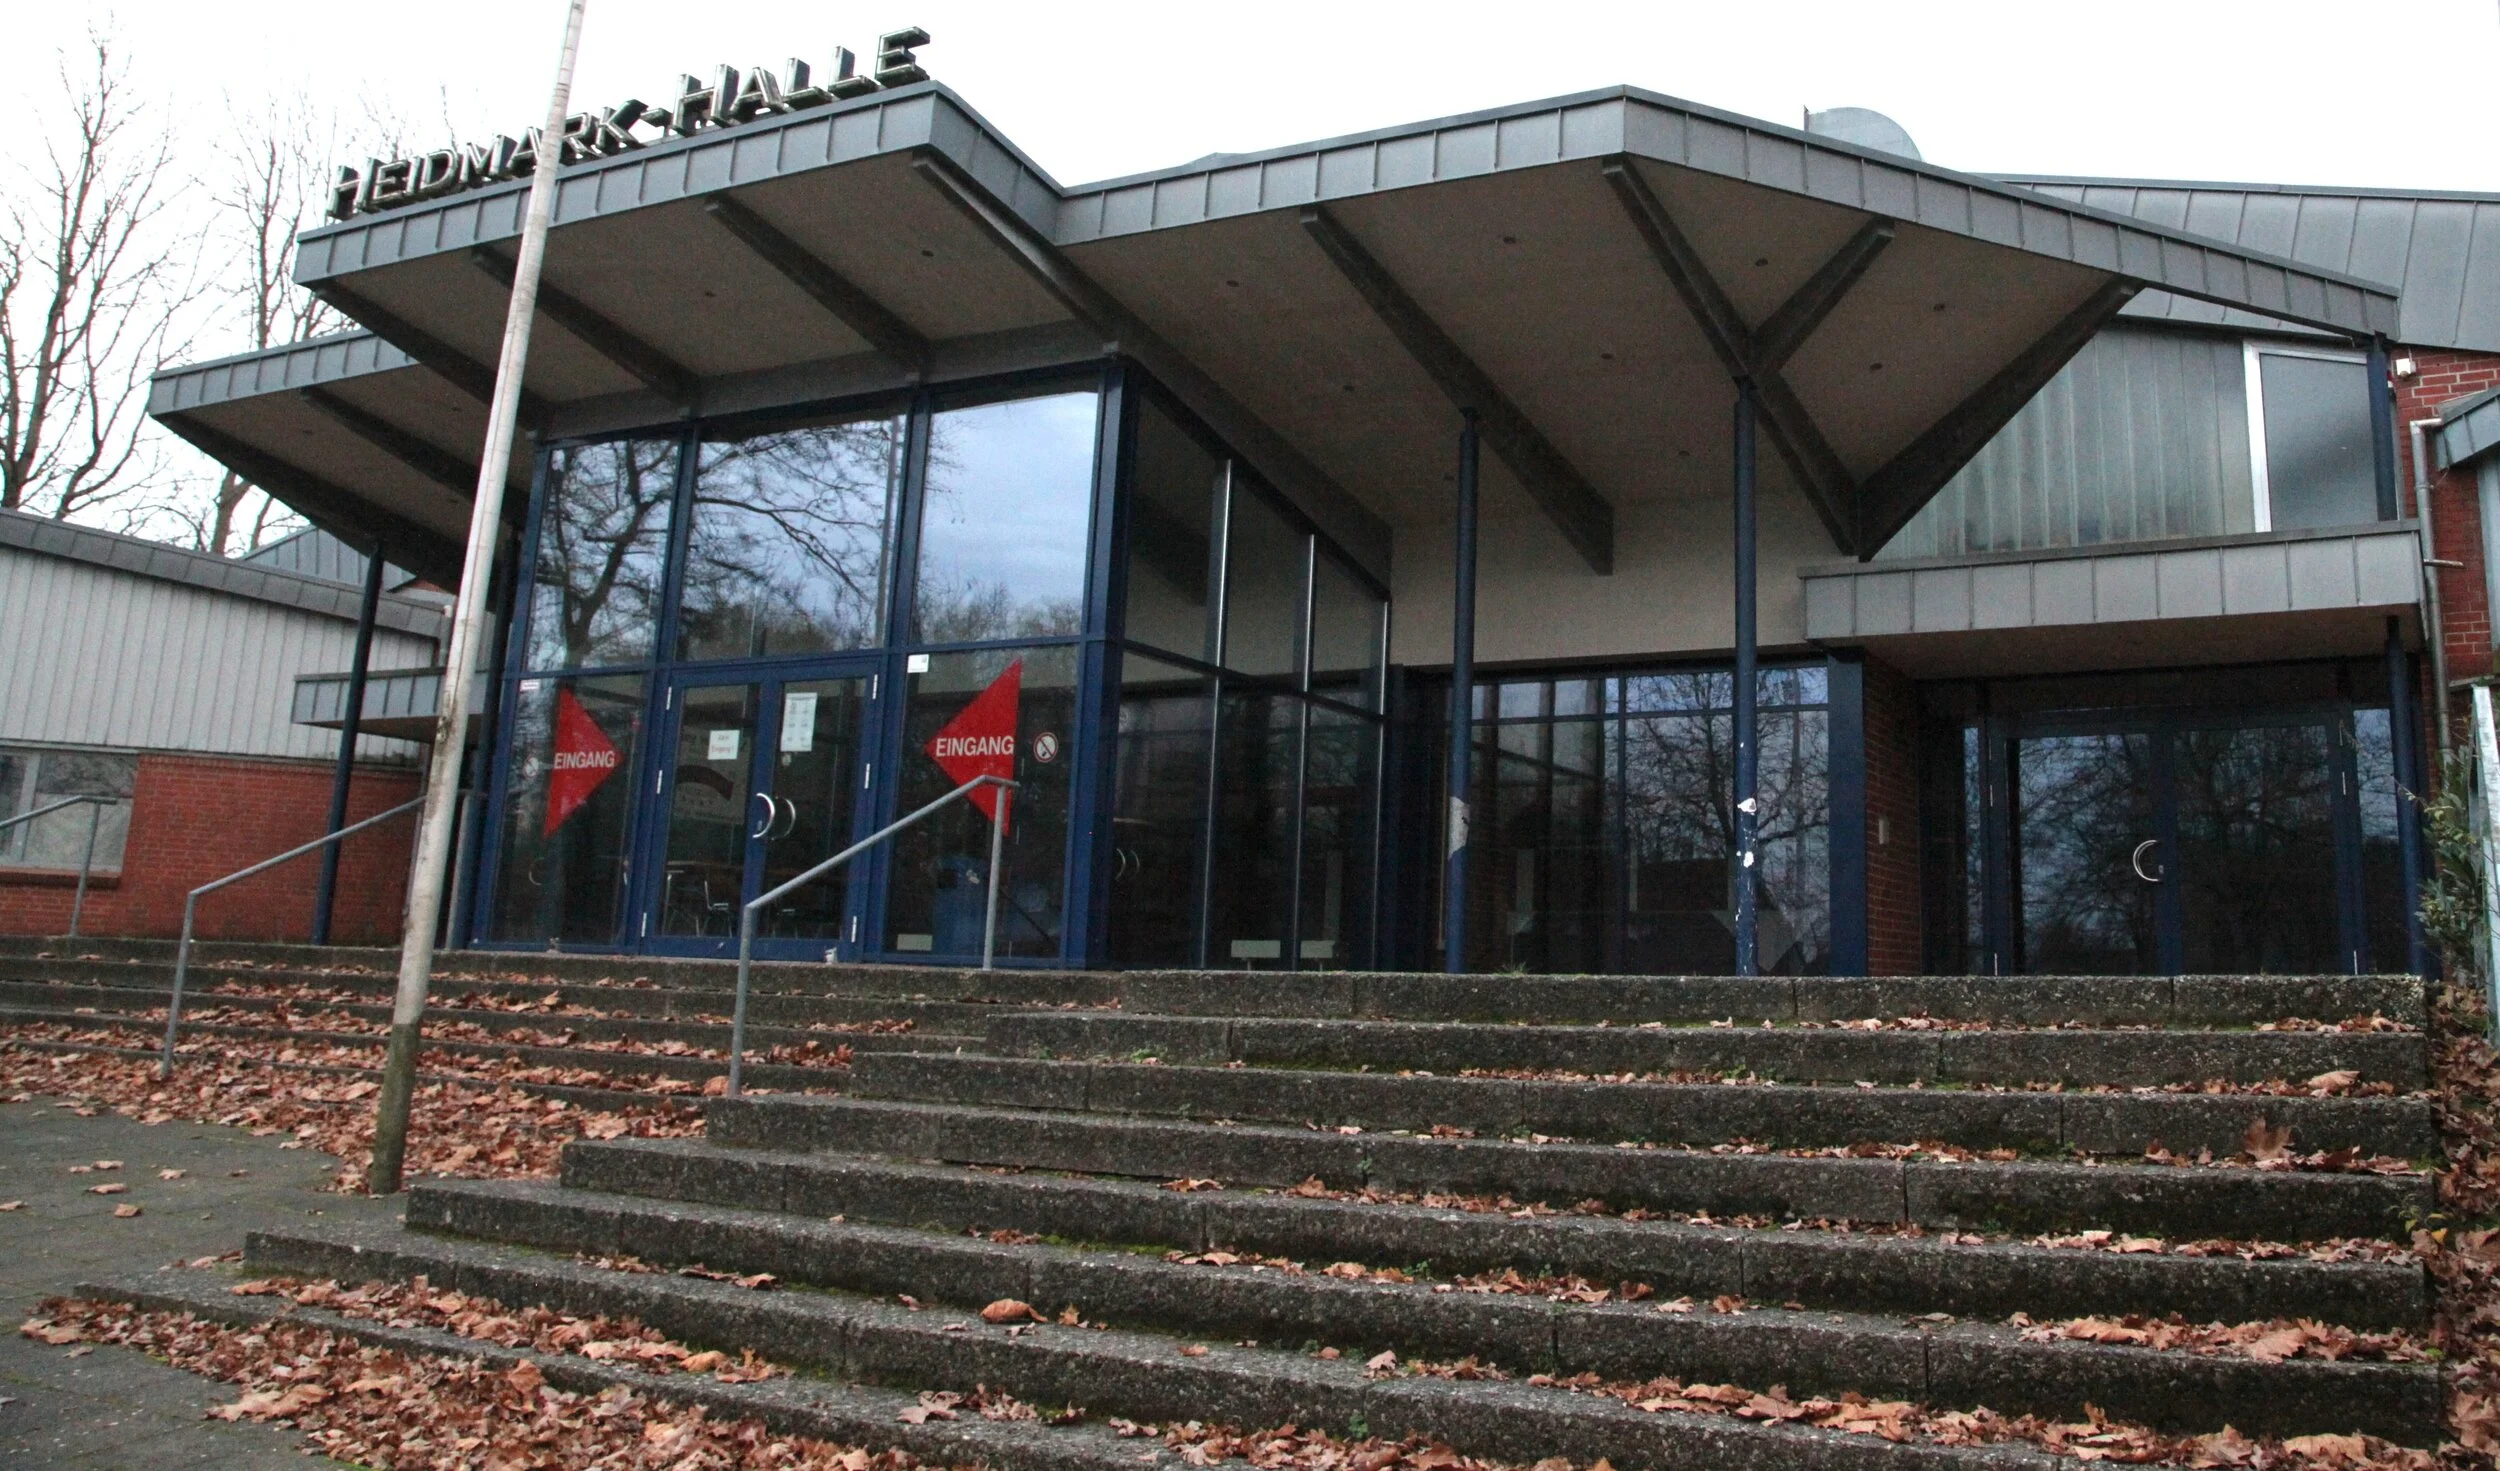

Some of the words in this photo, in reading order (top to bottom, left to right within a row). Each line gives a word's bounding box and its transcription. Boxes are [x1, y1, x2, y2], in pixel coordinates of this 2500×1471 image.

[327, 26, 931, 219] HEIDMARK-HALLE
[936, 735, 1014, 756] EINGANG
[554, 750, 615, 769] EINGANG
